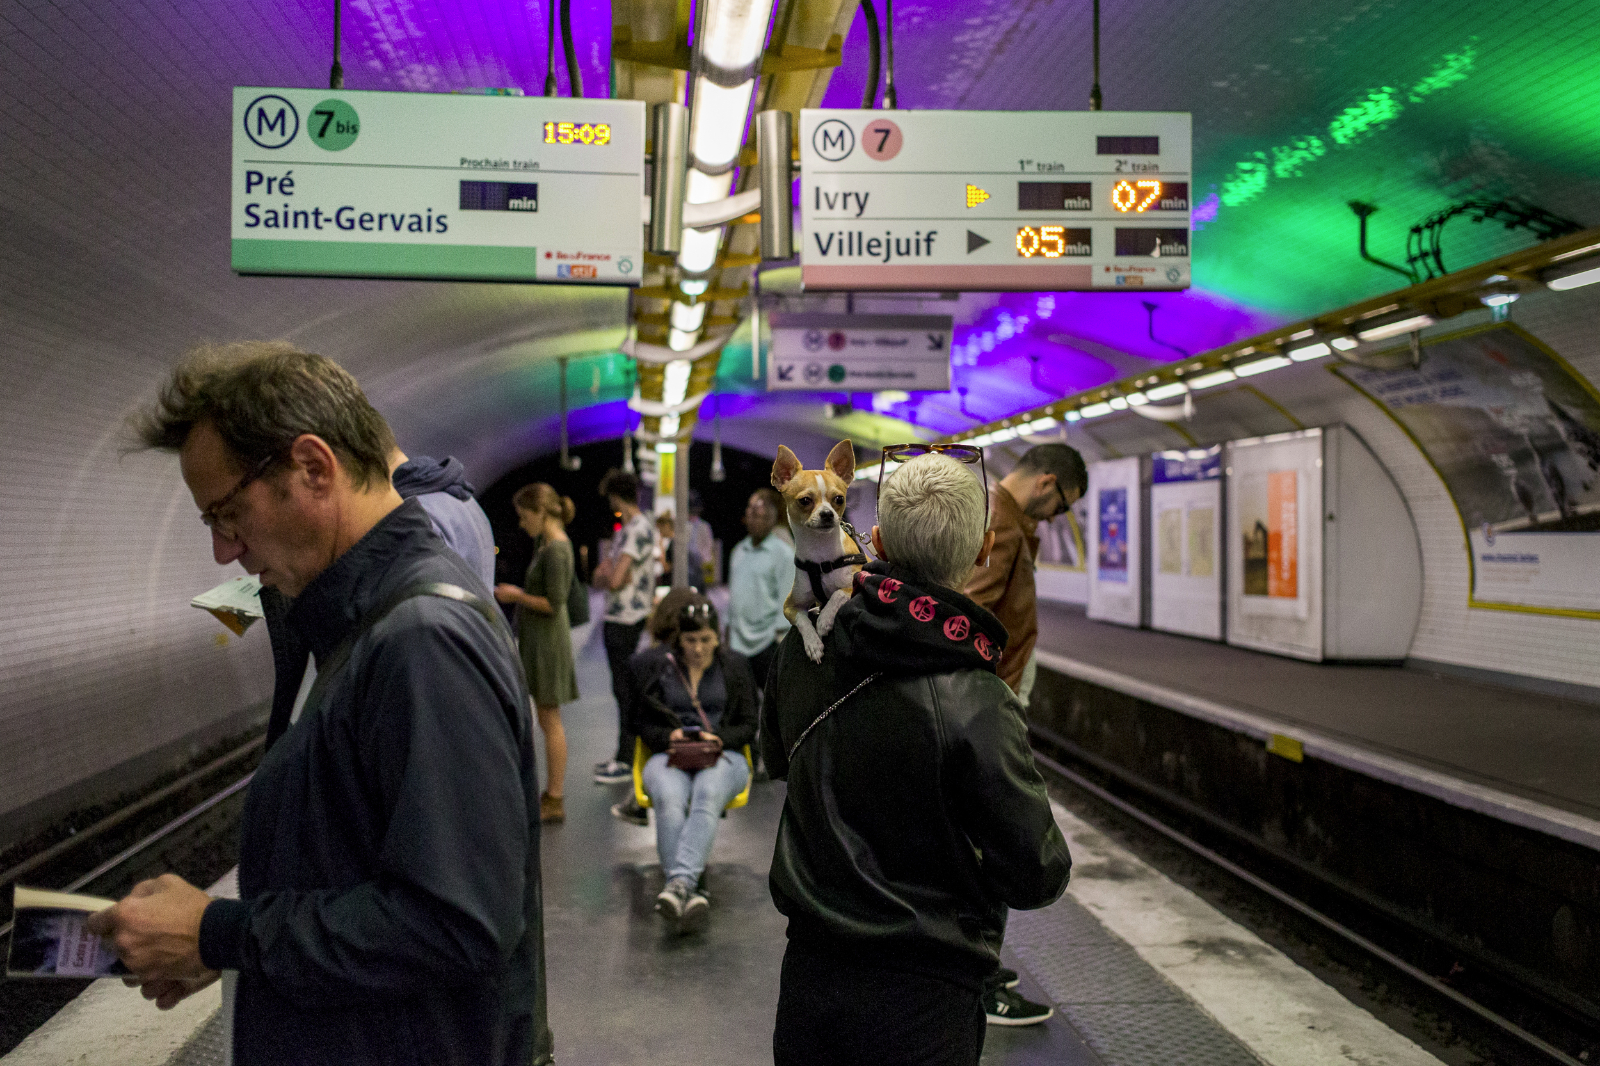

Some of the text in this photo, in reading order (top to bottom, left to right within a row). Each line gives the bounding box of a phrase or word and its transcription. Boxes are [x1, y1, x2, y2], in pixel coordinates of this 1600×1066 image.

[257, 107, 285, 137] M
[544, 121, 611, 146] 15:09
[823, 128, 891, 152] M 7
[460, 156, 539, 170] Prochain train
[1037, 160, 1065, 173] train
[1131, 160, 1160, 173] train
[245, 170, 295, 196] Pré
[508, 196, 537, 210] min
[814, 186, 870, 217] Ivry
[1064, 196, 1091, 210] min
[1112, 180, 1187, 213] 07 min
[244, 203, 449, 234] Saint-Gervais
[813, 230, 938, 263] Villejuif
[1016, 225, 1091, 258] 05 min
[1160, 242, 1187, 255] min
